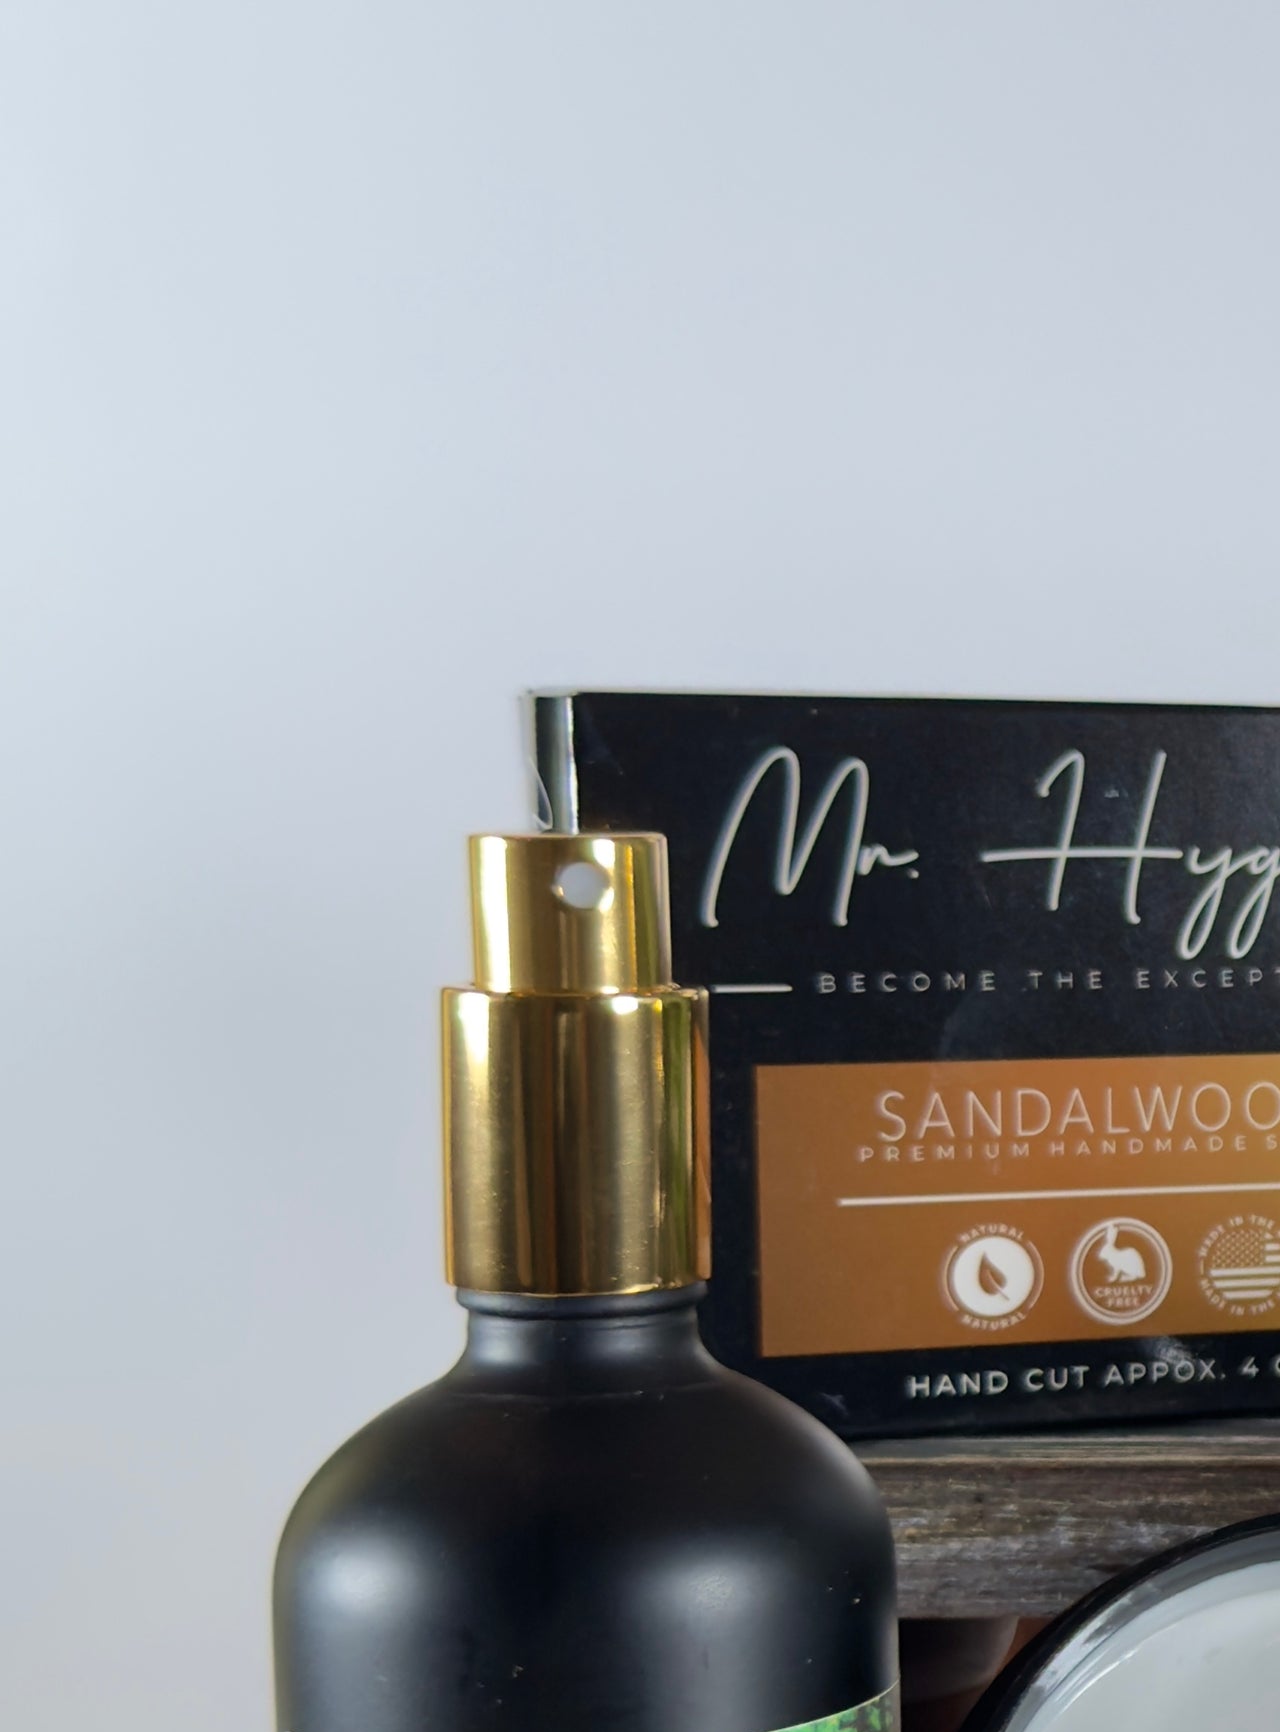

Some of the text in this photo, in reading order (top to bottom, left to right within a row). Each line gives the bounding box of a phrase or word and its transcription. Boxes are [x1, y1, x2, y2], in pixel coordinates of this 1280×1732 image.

[701, 746, 919, 926] Mr.
[819, 971, 995, 994] BECOME
[1027, 970, 1103, 990] THE
[858, 1142, 1030, 1163] PREMIUM
[1051, 1134, 1247, 1157] HANDMADE
[959, 1223, 1025, 1243] NATURAL
[1095, 1284, 1153, 1298] CRUELTY
[1107, 1297, 1140, 1308] FREE
[959, 1311, 1027, 1331] NATURAL
[907, 1371, 1009, 1400] HAND
[1020, 1366, 1091, 1393] CUT
[1102, 1359, 1227, 1389] APPOX.
[1241, 1356, 1259, 1378] 4
